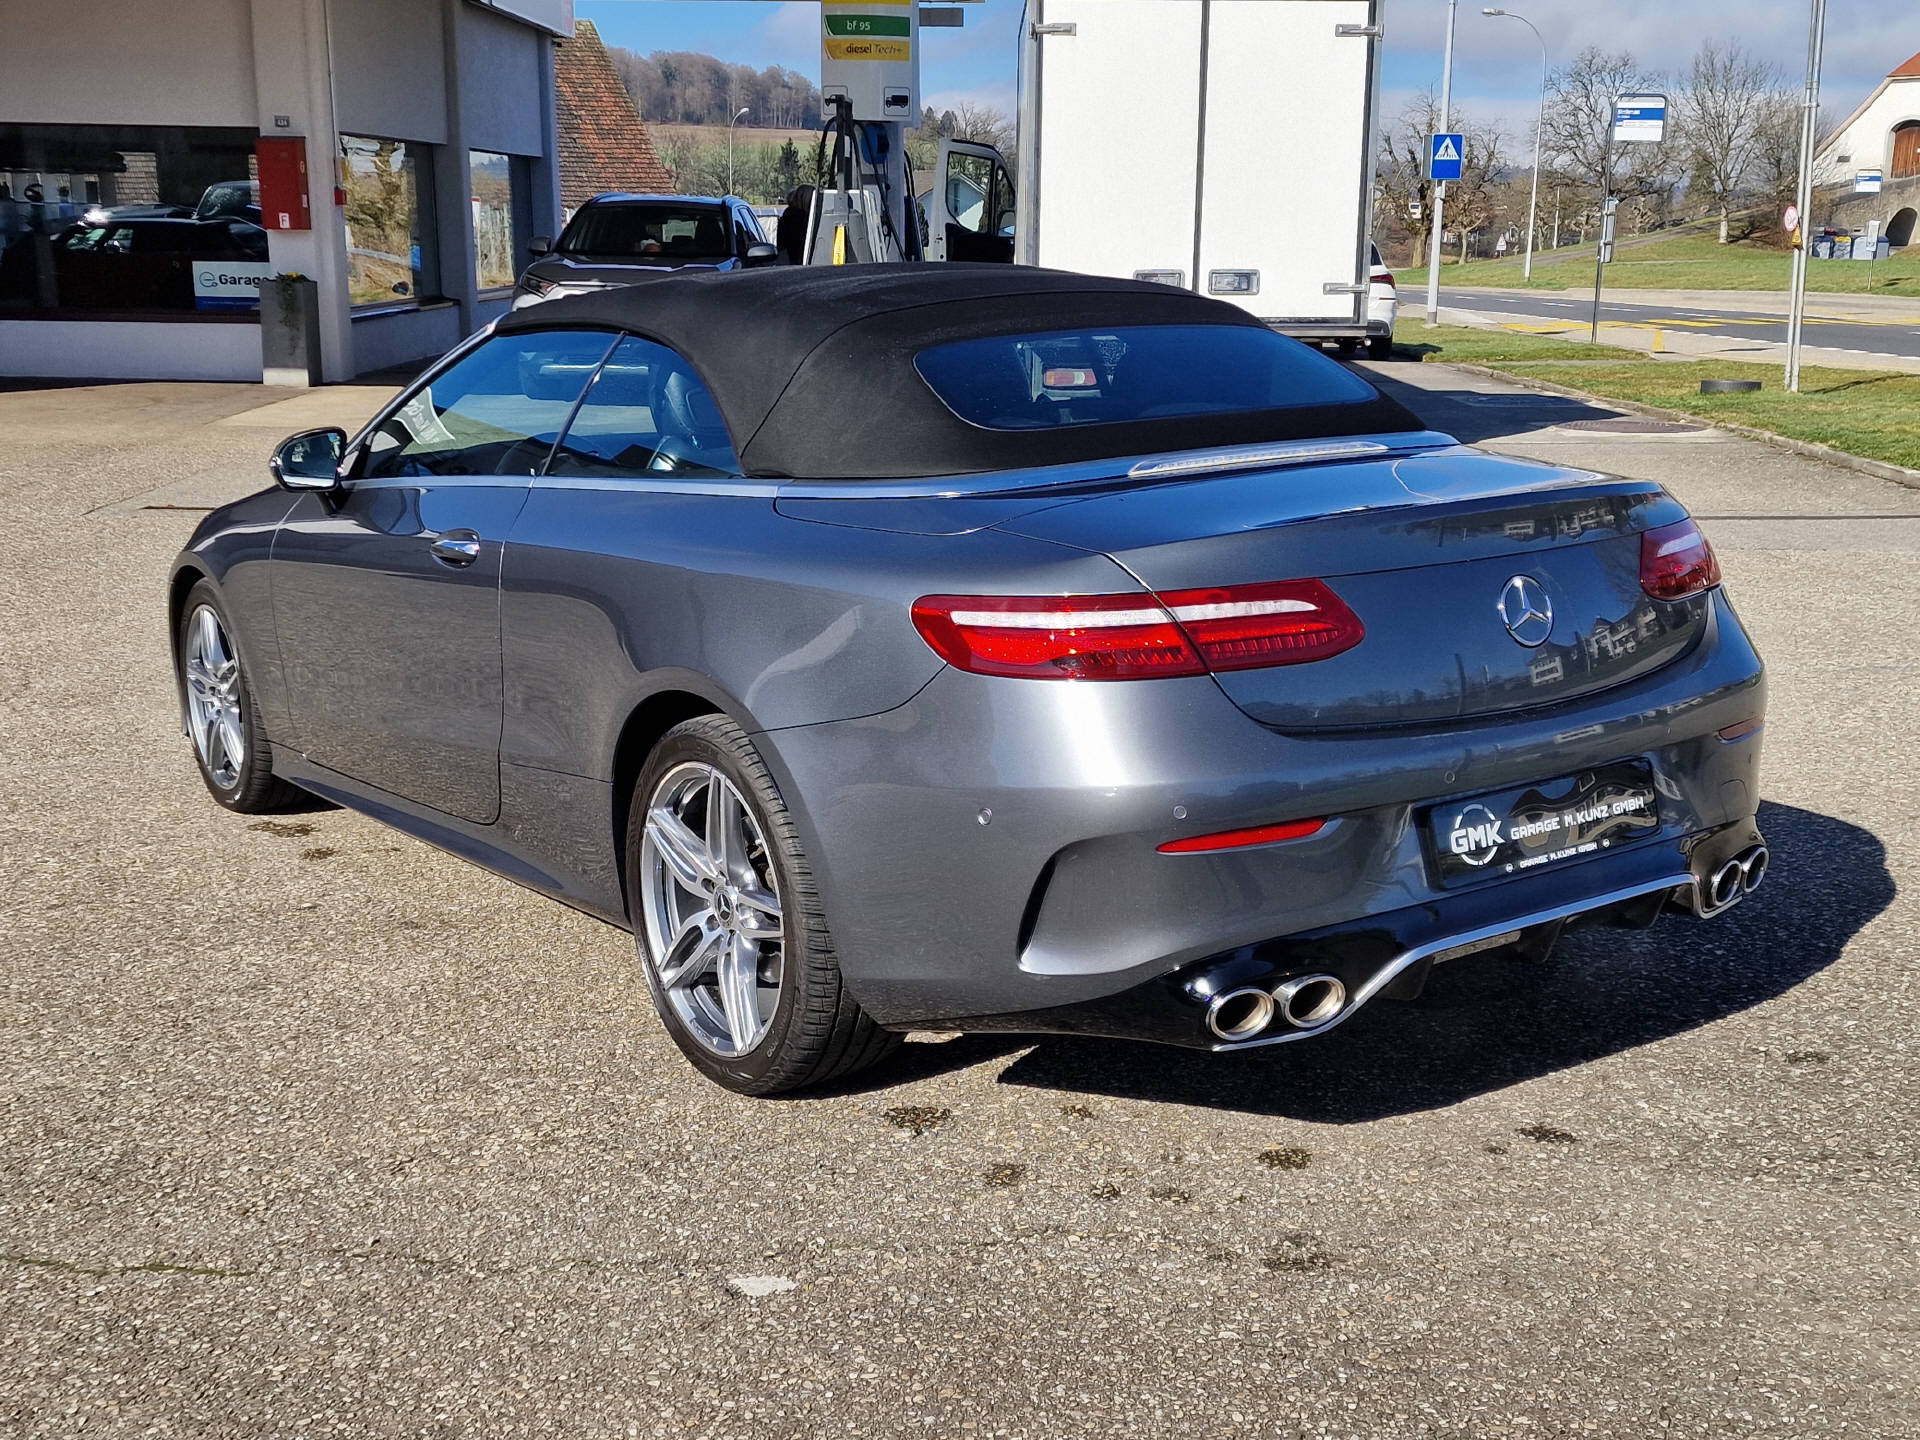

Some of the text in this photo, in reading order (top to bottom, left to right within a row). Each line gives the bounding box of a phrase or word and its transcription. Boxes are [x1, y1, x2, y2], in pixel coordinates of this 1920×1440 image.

[846, 20, 871, 31] bf 95
[846, 43, 872, 54] diesel
[1510, 796, 1645, 839] GARAGE M.KUNZ GMBH
[1450, 820, 1506, 854] GMK
[1519, 854, 1549, 869] GARAGE
